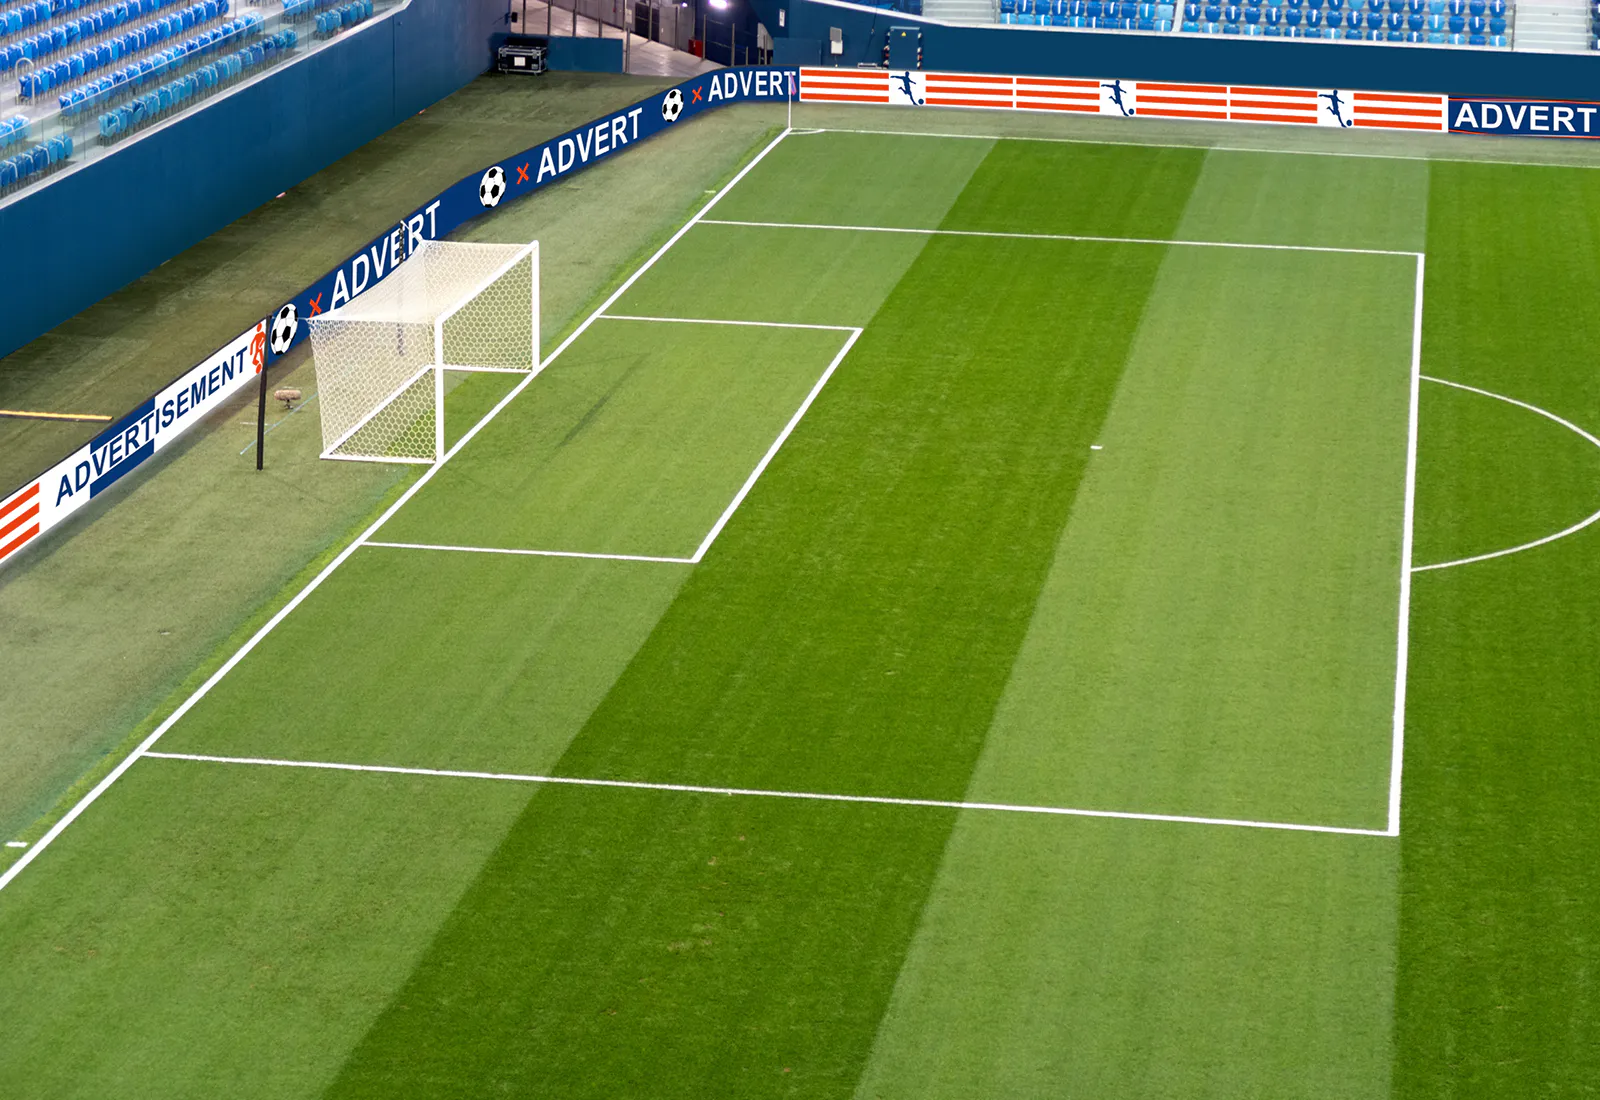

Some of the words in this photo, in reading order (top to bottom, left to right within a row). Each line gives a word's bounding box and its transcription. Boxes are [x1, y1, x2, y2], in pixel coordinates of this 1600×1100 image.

[708, 71, 796, 102] ADVERT
[1453, 102, 1597, 133] ADVERT
[536, 107, 643, 183] ADVERT
[330, 199, 440, 311] ADVERT
[55, 346, 248, 507] ADVERTISEMENT
